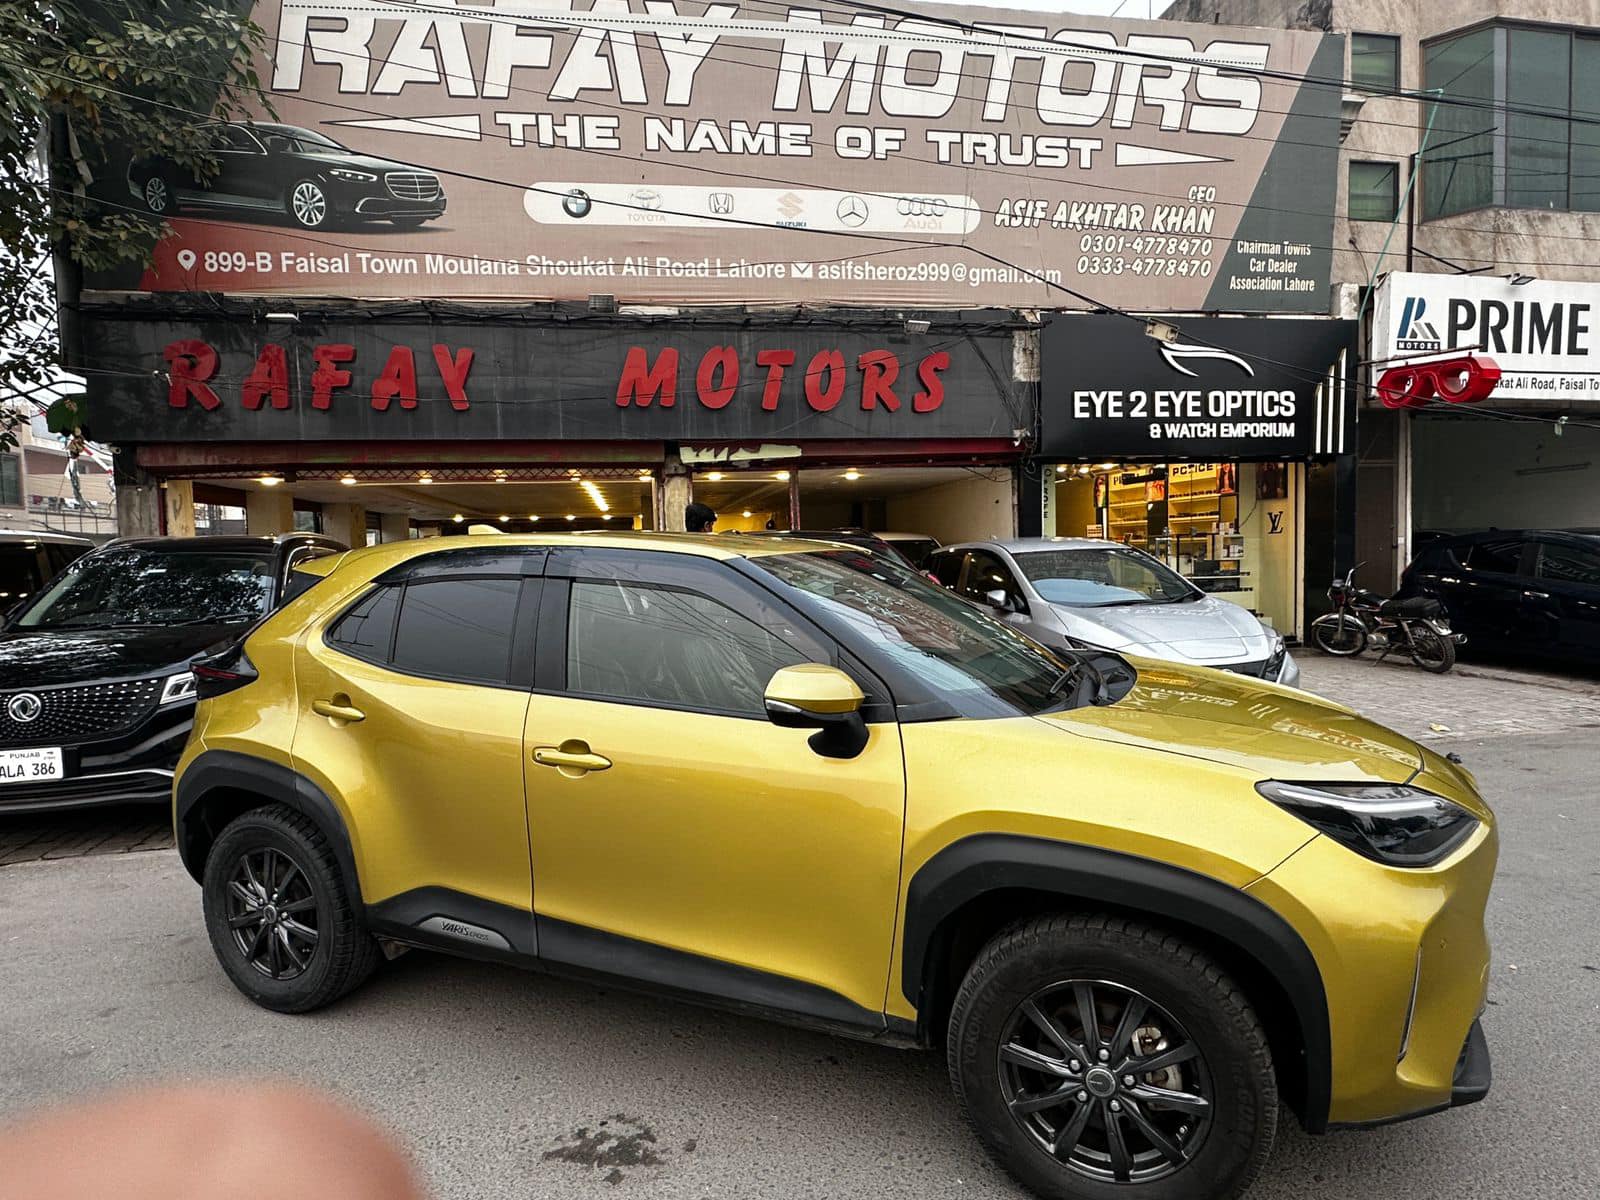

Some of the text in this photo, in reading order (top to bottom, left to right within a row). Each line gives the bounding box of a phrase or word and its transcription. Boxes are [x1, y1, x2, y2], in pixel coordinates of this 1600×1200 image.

[271, 0, 1271, 136] RAFAY MOTORS
[495, 112, 1103, 169] THE NAME OF TRUST
[1188, 185, 1216, 204] CEO
[627, 213, 666, 223] TOYOTA
[903, 217, 943, 231] Audi
[994, 198, 1216, 234] ASIF AKHTAR KHAN
[1080, 234, 1213, 256] 0301-4778470
[1237, 240, 1281, 255] Chairman
[204, 251, 1062, 286] 899-B Faisal Town Moulana Shoukat Ali Road Lahore asifsheroz999@gmail.com
[1077, 256, 1212, 278] 0333-4778470
[1249, 258, 1298, 273] Car Dealer
[1229, 275, 1315, 292] Association Lahore
[1447, 298, 1591, 356] PRIME
[1398, 341, 1440, 351] MOTORS
[163, 338, 951, 413] RAFAY MOTORS
[1516, 378, 1528, 390] Ali
[1531, 378, 1557, 392] Road,
[1559, 378, 1587, 391] Faisal
[1073, 390, 1296, 418] EYE 2 EYE OPTICS
[1149, 422, 1296, 439] & WATCH EMPORIUM
[0, 762, 56, 778] ALA 386
